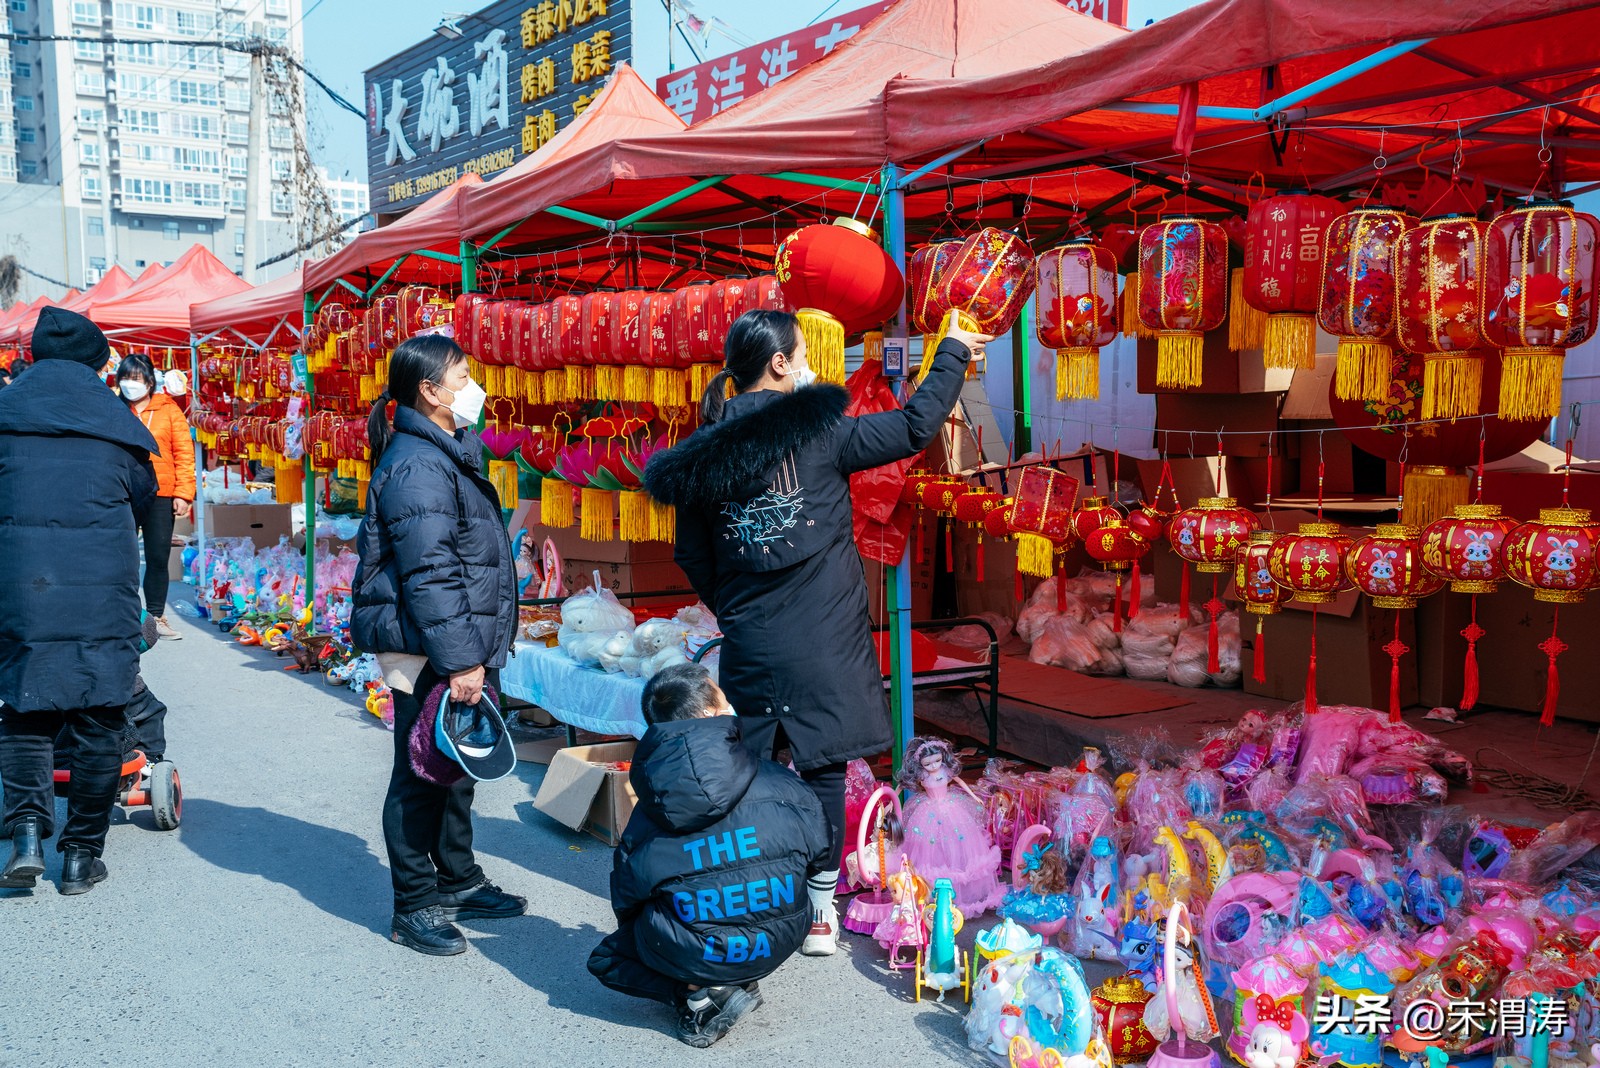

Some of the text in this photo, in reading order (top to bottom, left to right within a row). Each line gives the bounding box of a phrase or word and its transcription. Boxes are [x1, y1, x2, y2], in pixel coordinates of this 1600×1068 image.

[385, 29, 509, 166] 大碗酒
[521, 57, 555, 103] 烤肉
[683, 826, 761, 870] THE
[672, 874, 795, 922] GREEN
[703, 932, 771, 964] LBA
